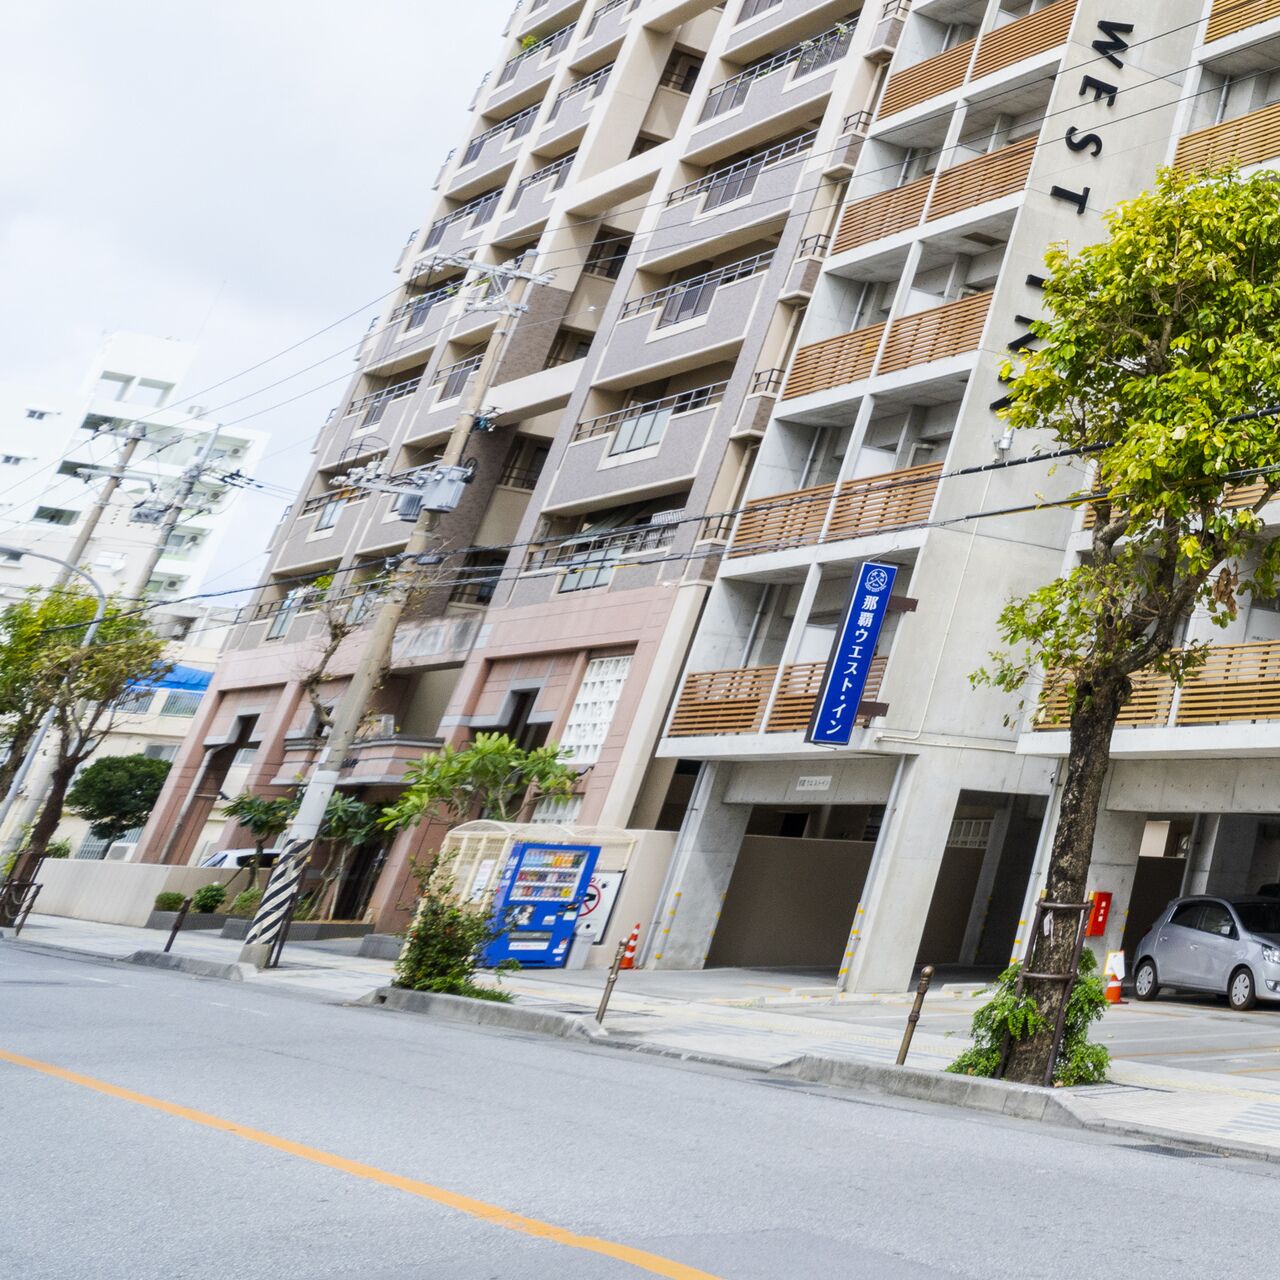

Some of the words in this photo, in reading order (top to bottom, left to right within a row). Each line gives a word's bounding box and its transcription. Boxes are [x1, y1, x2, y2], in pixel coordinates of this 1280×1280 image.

[1050, 19, 1135, 215] WEST
[826, 594, 880, 736] 那覇ウエスト・イン
